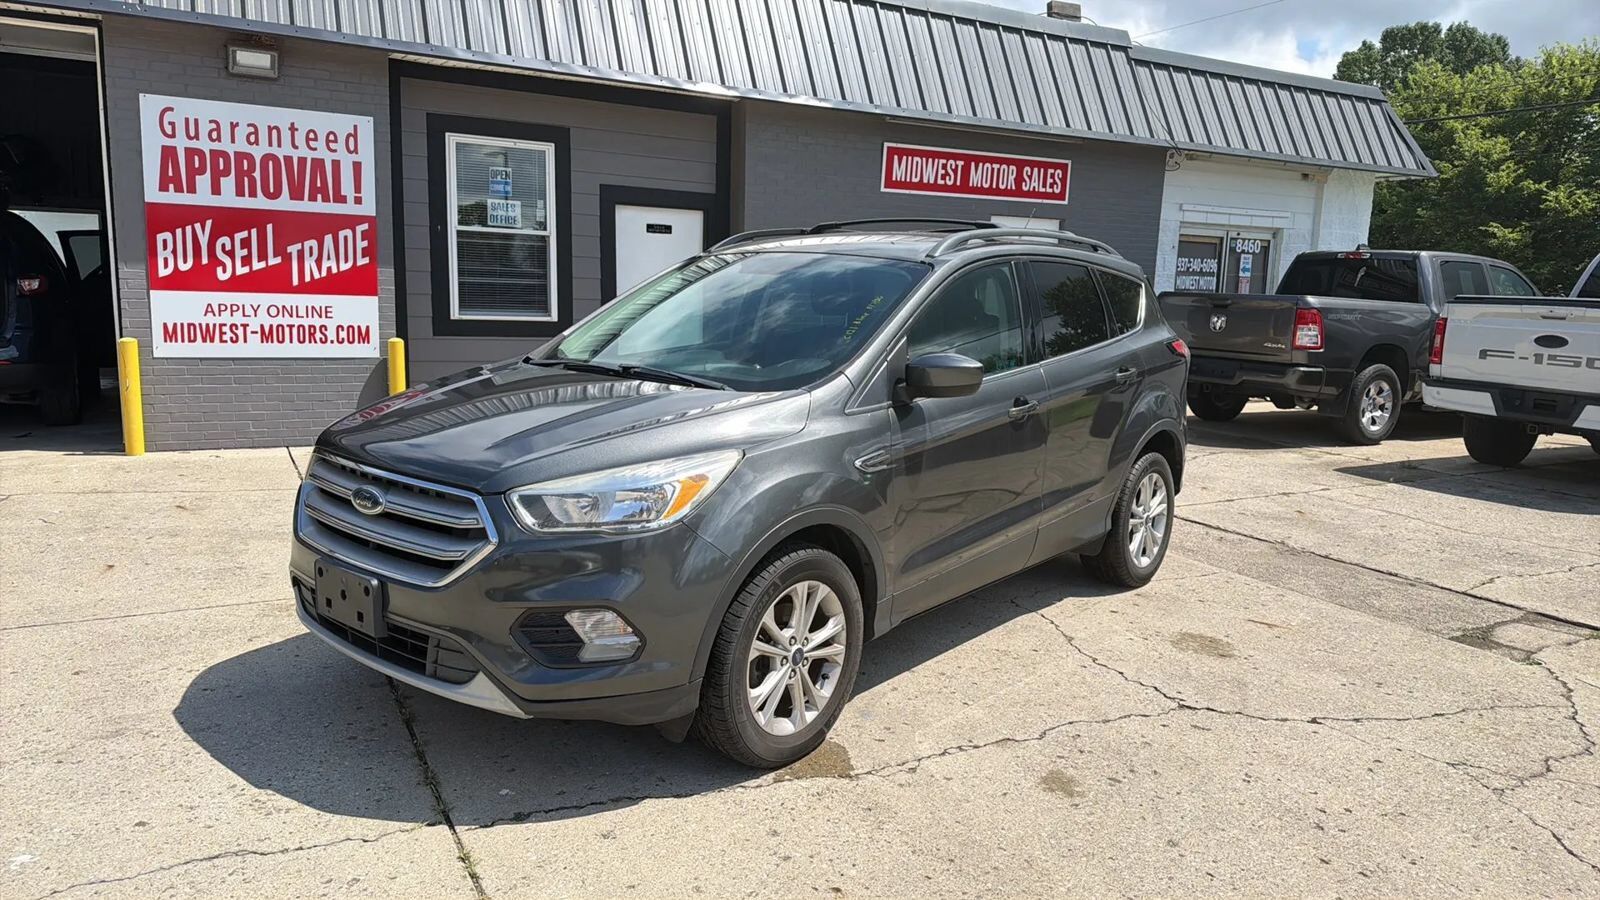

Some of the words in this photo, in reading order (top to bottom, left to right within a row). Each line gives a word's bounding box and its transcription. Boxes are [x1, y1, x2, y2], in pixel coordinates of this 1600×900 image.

[158, 106, 359, 155] Guaranteed
[158, 144, 363, 205] APPROVAL!
[490, 168, 511, 180] OPEN
[892, 154, 965, 187] MIDWEST
[969, 161, 1017, 190] MOTOR
[1022, 166, 1063, 194] SALES
[490, 202, 516, 212] SALES
[489, 213, 517, 225] OFFICE
[156, 219, 213, 278] BUY
[215, 223, 282, 281] SELL
[287, 222, 370, 287] TRADE
[1236, 239, 1261, 253] 8460
[1177, 257, 1218, 273] 937-340-6096
[1176, 275, 1200, 290] MIDWEST
[203, 303, 261, 318] APPLY
[266, 304, 334, 319] ONLINE
[162, 322, 371, 345] MIDWEST-MOTORS.COM
